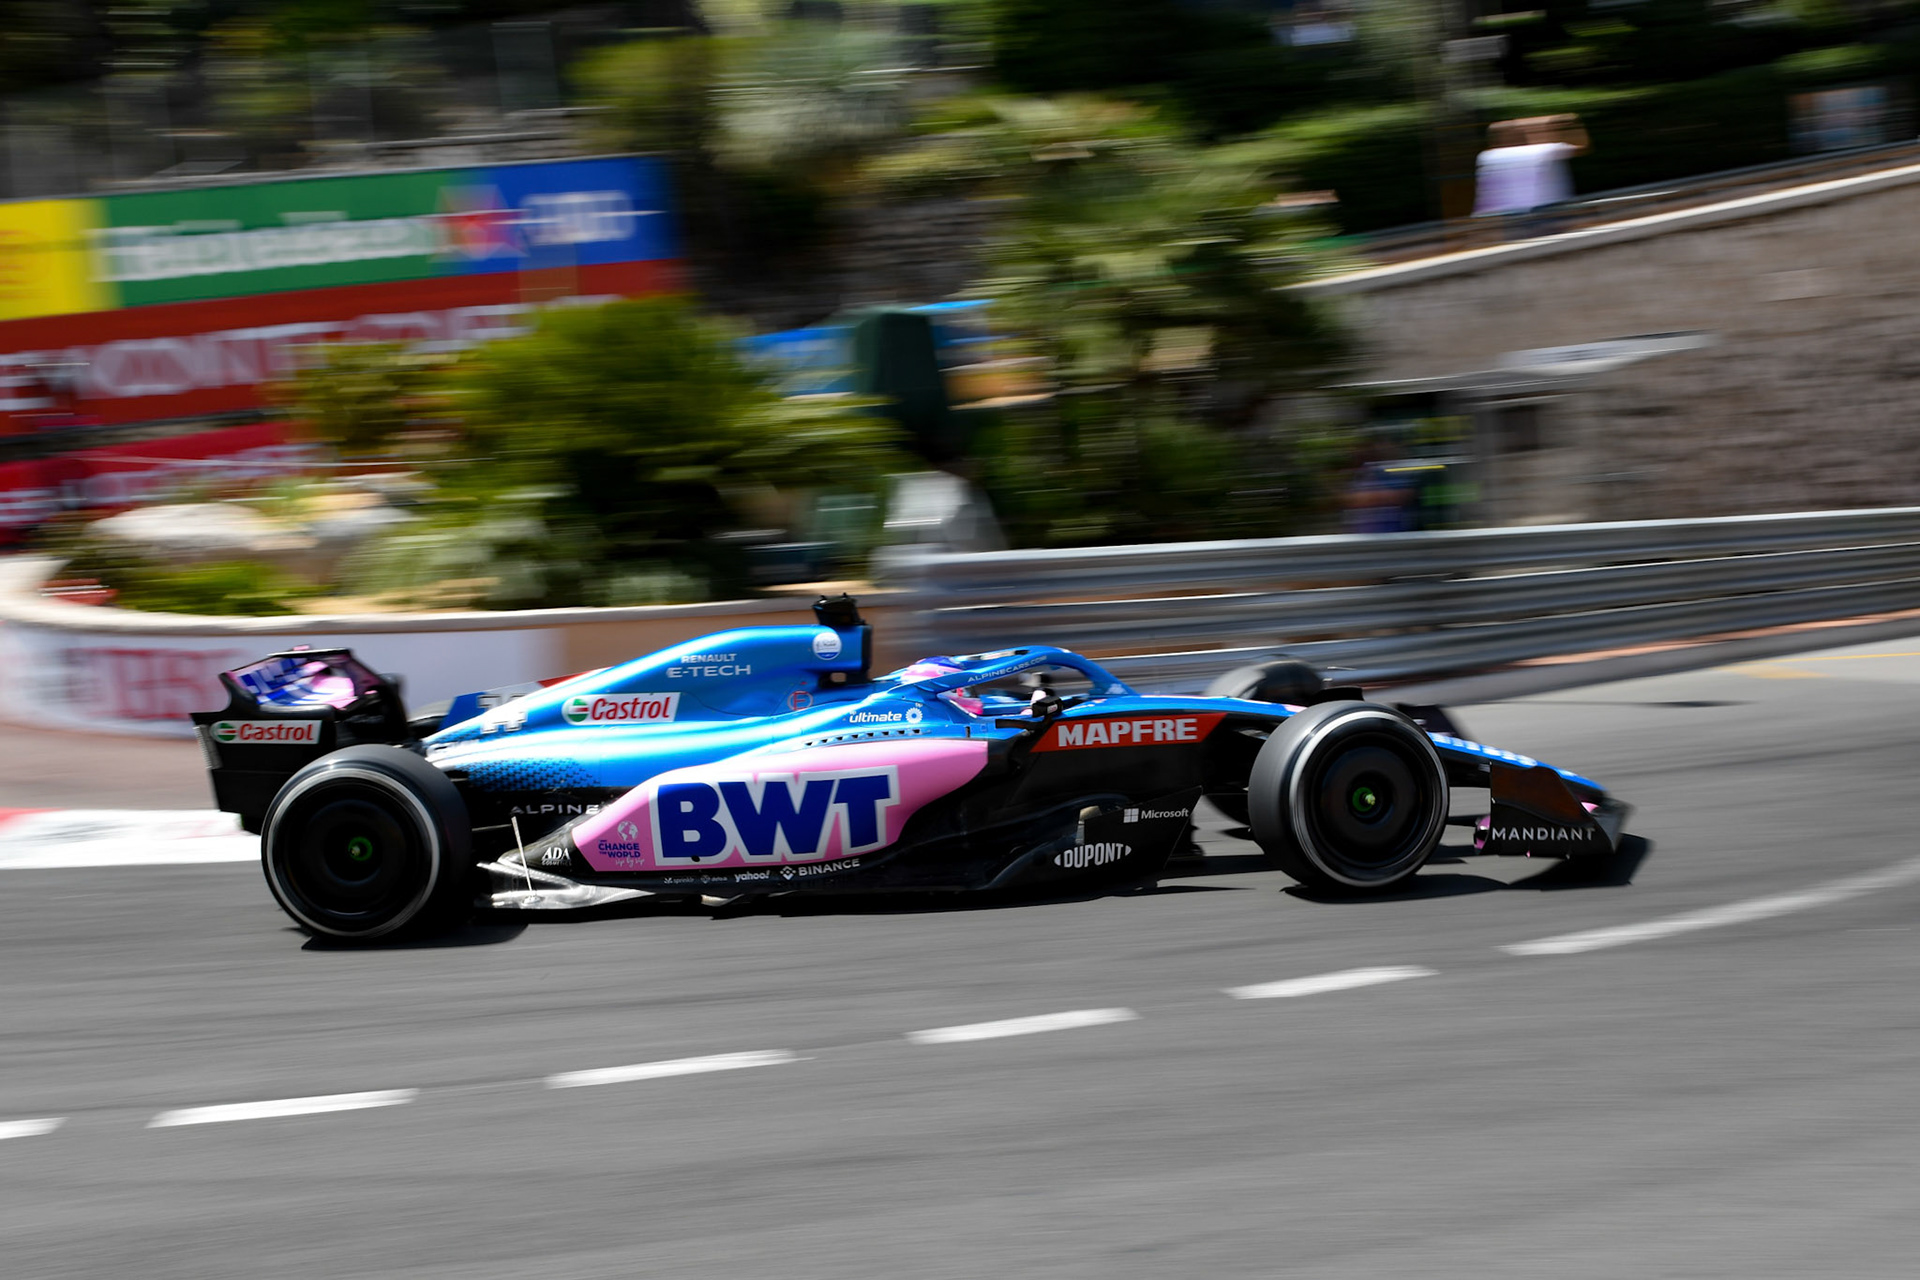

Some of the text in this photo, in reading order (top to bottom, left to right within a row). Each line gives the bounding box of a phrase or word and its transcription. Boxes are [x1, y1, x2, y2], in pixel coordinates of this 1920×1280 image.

[681, 653, 738, 664] RENAULT
[666, 664, 752, 678] E-TECH
[967, 655, 1048, 683] ALPINECARS.COM
[591, 697, 672, 721] Castrol
[848, 711, 903, 723] ultimate
[239, 723, 314, 741] Castrol
[1057, 718, 1198, 748] MAPFRE
[510, 804, 601, 815] ALPINE
[655, 773, 892, 860] BWT
[1141, 807, 1189, 820] Microsoft
[1491, 826, 1596, 841] MANDIANT
[540, 847, 571, 860] ADA
[598, 843, 640, 851] CHANGE
[1063, 842, 1125, 869] DUPONT
[798, 859, 861, 876] BINANCE
[734, 870, 771, 883] yahoo!
